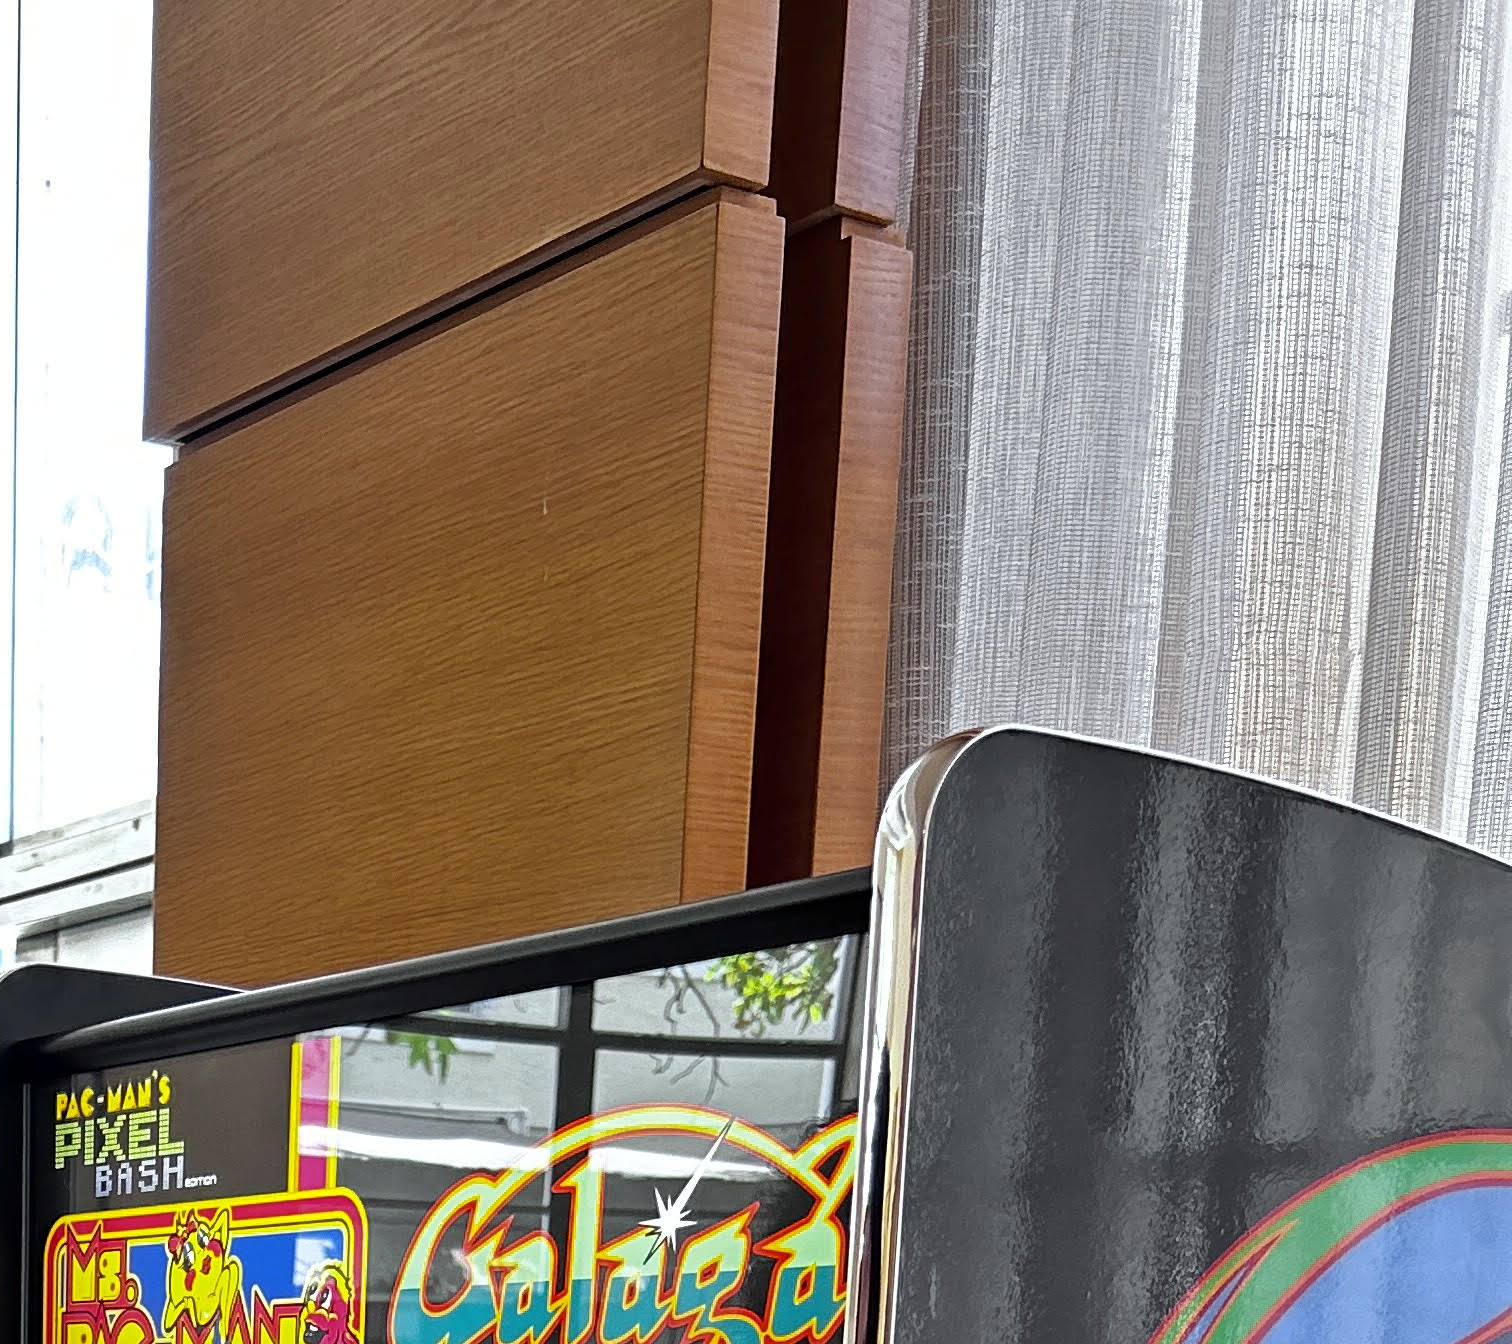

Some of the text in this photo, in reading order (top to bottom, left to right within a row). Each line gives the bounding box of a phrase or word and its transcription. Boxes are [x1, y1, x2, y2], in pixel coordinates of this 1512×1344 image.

[55, 1070, 171, 1121] PAC-MAN'S
[55, 1108, 185, 1170] PIXEL
[95, 1155, 185, 1198] BASH
